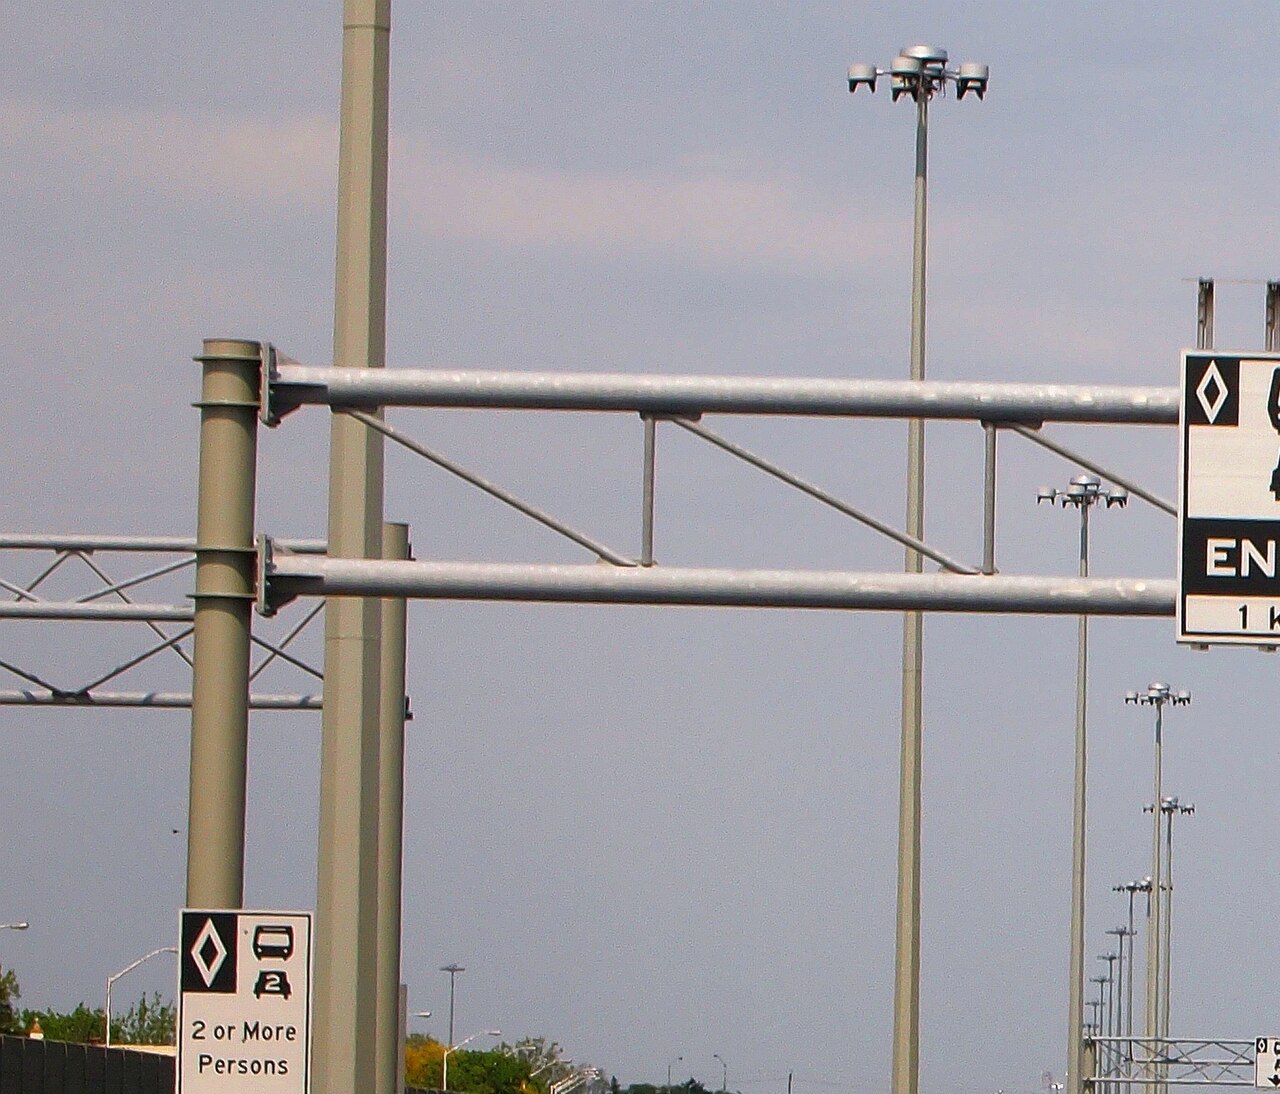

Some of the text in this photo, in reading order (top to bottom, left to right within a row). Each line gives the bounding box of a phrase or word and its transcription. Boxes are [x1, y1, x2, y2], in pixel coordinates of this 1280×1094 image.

[1238, 605, 1249, 630] 1
[264, 974, 281, 991] 2
[191, 1021, 296, 1041] 2 or More
[198, 1055, 289, 1075] Persons
